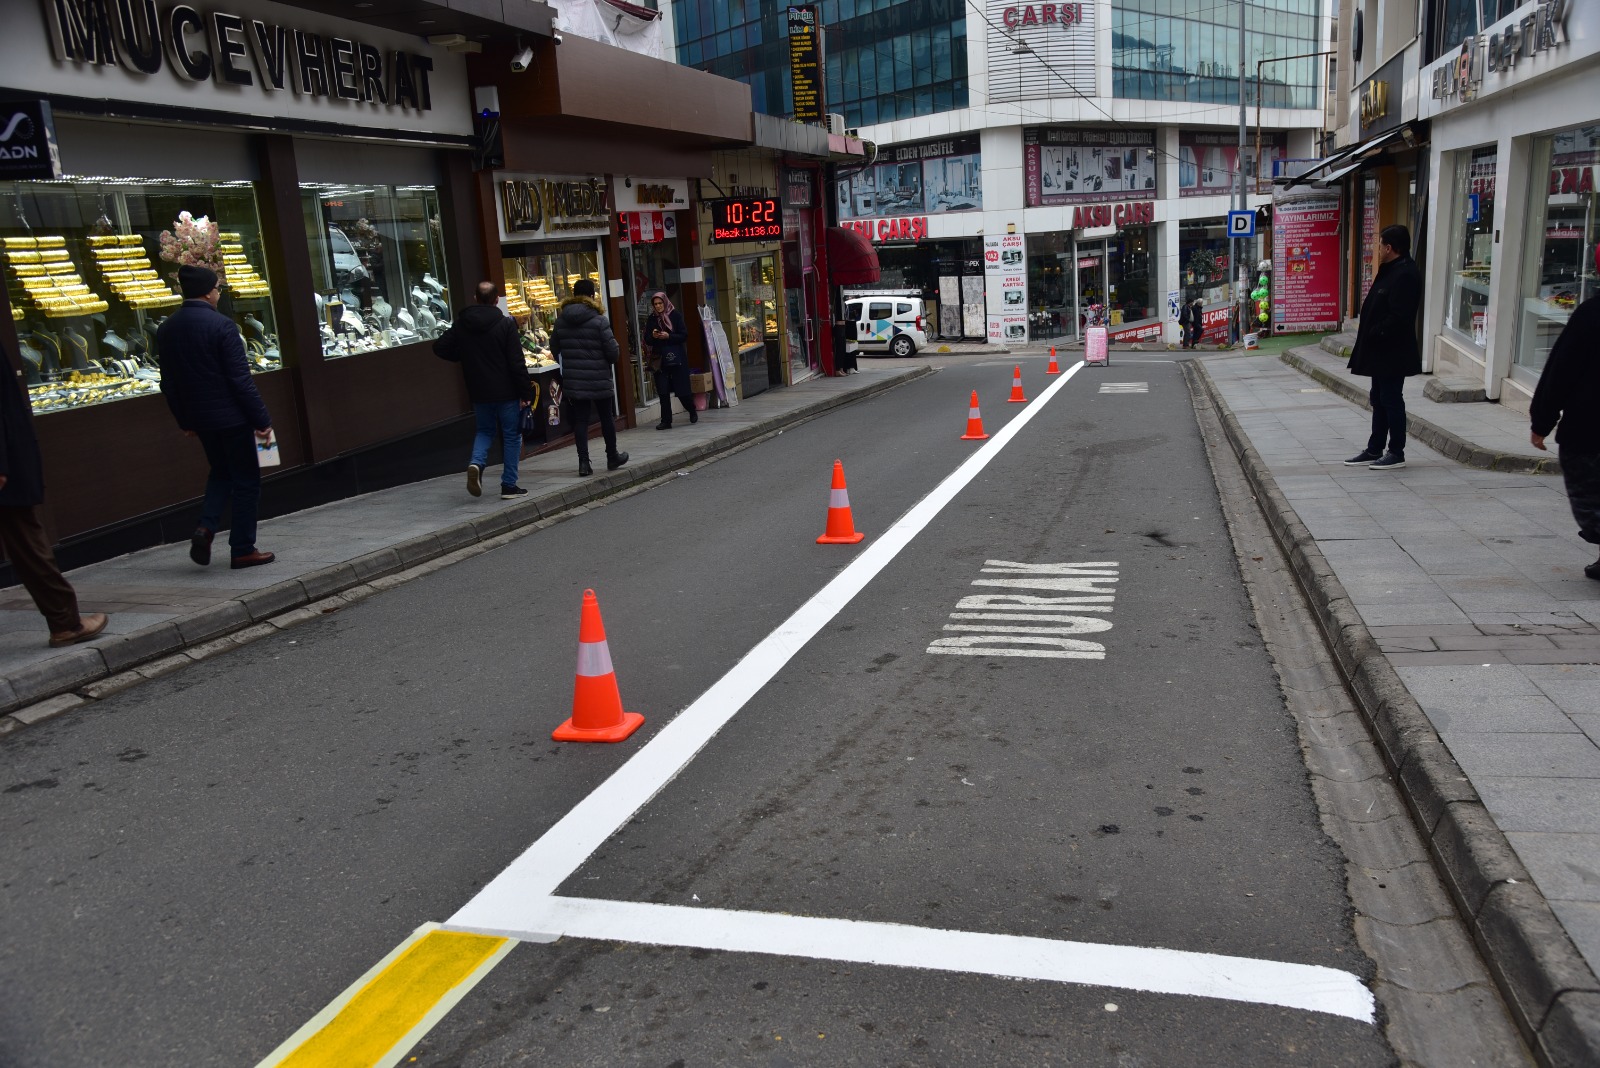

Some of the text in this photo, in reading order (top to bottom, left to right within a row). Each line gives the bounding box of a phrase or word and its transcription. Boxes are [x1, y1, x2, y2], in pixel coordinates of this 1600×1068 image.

[1003, 3, 1082, 33] ÇARŞI
[895, 147, 918, 160] ELDEN
[726, 200, 775, 224] 10:22
[1073, 202, 1154, 230] AKSU ÇARŞI
[1234, 217, 1248, 231] D
[1280, 213, 1334, 223] YAYINLARIMIZ
[878, 217, 929, 245] ÇARŞI
[926, 559, 1120, 660] DURAK
